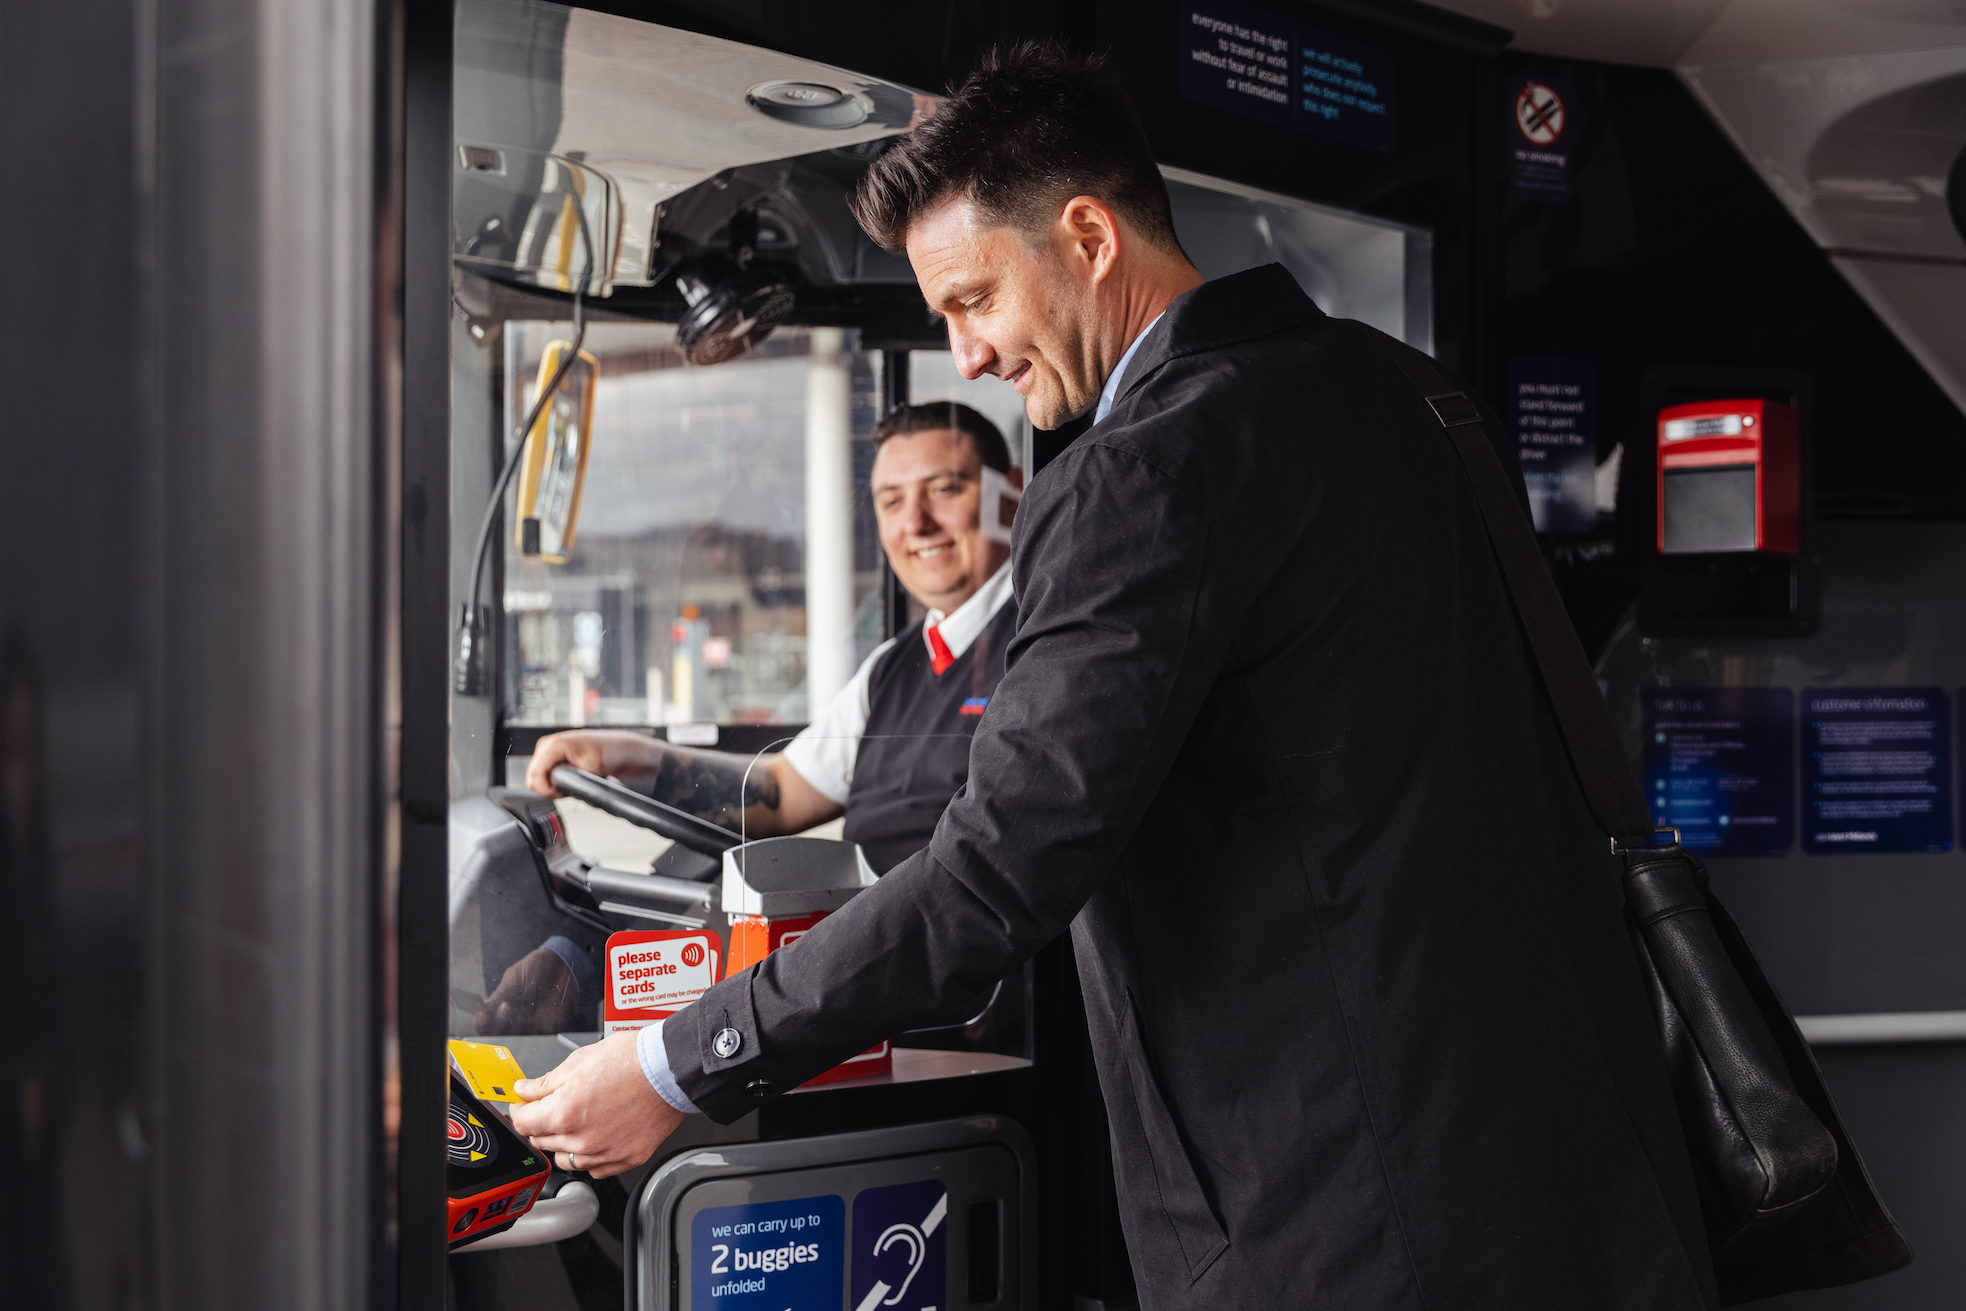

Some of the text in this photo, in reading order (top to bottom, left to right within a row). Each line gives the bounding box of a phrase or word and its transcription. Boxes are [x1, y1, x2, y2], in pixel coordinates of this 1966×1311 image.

[1192, 13, 1288, 52] everyone has the right
[1218, 38, 1288, 69] to travel or work
[1302, 48, 1316, 61] we
[1331, 56, 1363, 76] actively
[1191, 49, 1288, 87] without fear of assault
[1302, 65, 1377, 98] prosecute anybody
[1226, 78, 1289, 104] or intimidation
[1320, 104, 1340, 120] right
[1528, 151, 1567, 168] smoking
[1518, 384, 1581, 397] you must not
[1518, 399, 1585, 413] stand forward
[1518, 414, 1575, 429] of this point
[1518, 432, 1585, 446] or distract the
[1519, 448, 1548, 461] driver
[1812, 697, 1929, 712] customer information
[618, 951, 661, 968] please
[619, 964, 676, 981] separate
[621, 981, 655, 995] cards
[655, 992, 666, 1000] card
[686, 987, 706, 996] charged
[712, 1214, 820, 1238] we can carry up to
[711, 1241, 819, 1274] 2 buggies
[712, 1277, 766, 1297] unfolded
